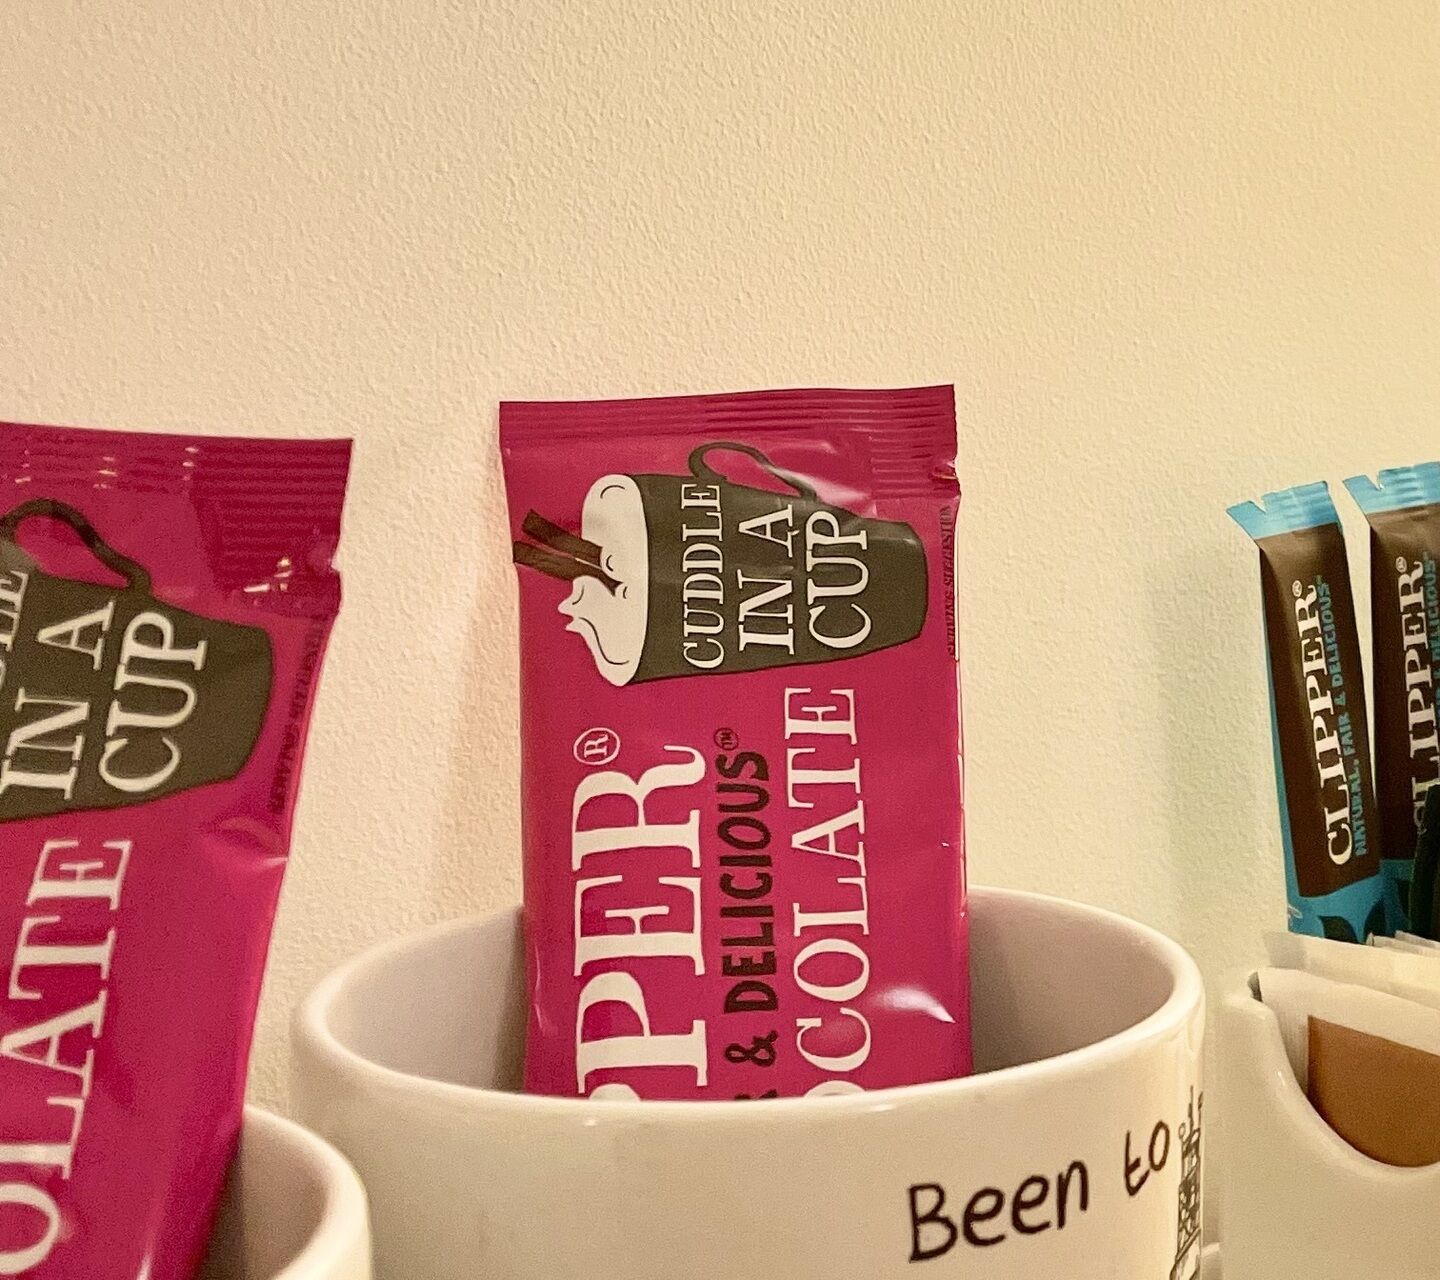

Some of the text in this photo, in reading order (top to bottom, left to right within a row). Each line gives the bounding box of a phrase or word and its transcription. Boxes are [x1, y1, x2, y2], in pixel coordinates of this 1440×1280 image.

[681, 482, 726, 671] CUDDLE
[738, 503, 796, 656] IN A
[805, 509, 873, 650] CUP
[0, 600, 114, 801] IN A
[98, 611, 208, 793] CUP
[1337, 710, 1356, 757] FAIR
[723, 1029, 779, 1067] &
[908, 1120, 1170, 1263] Been to
